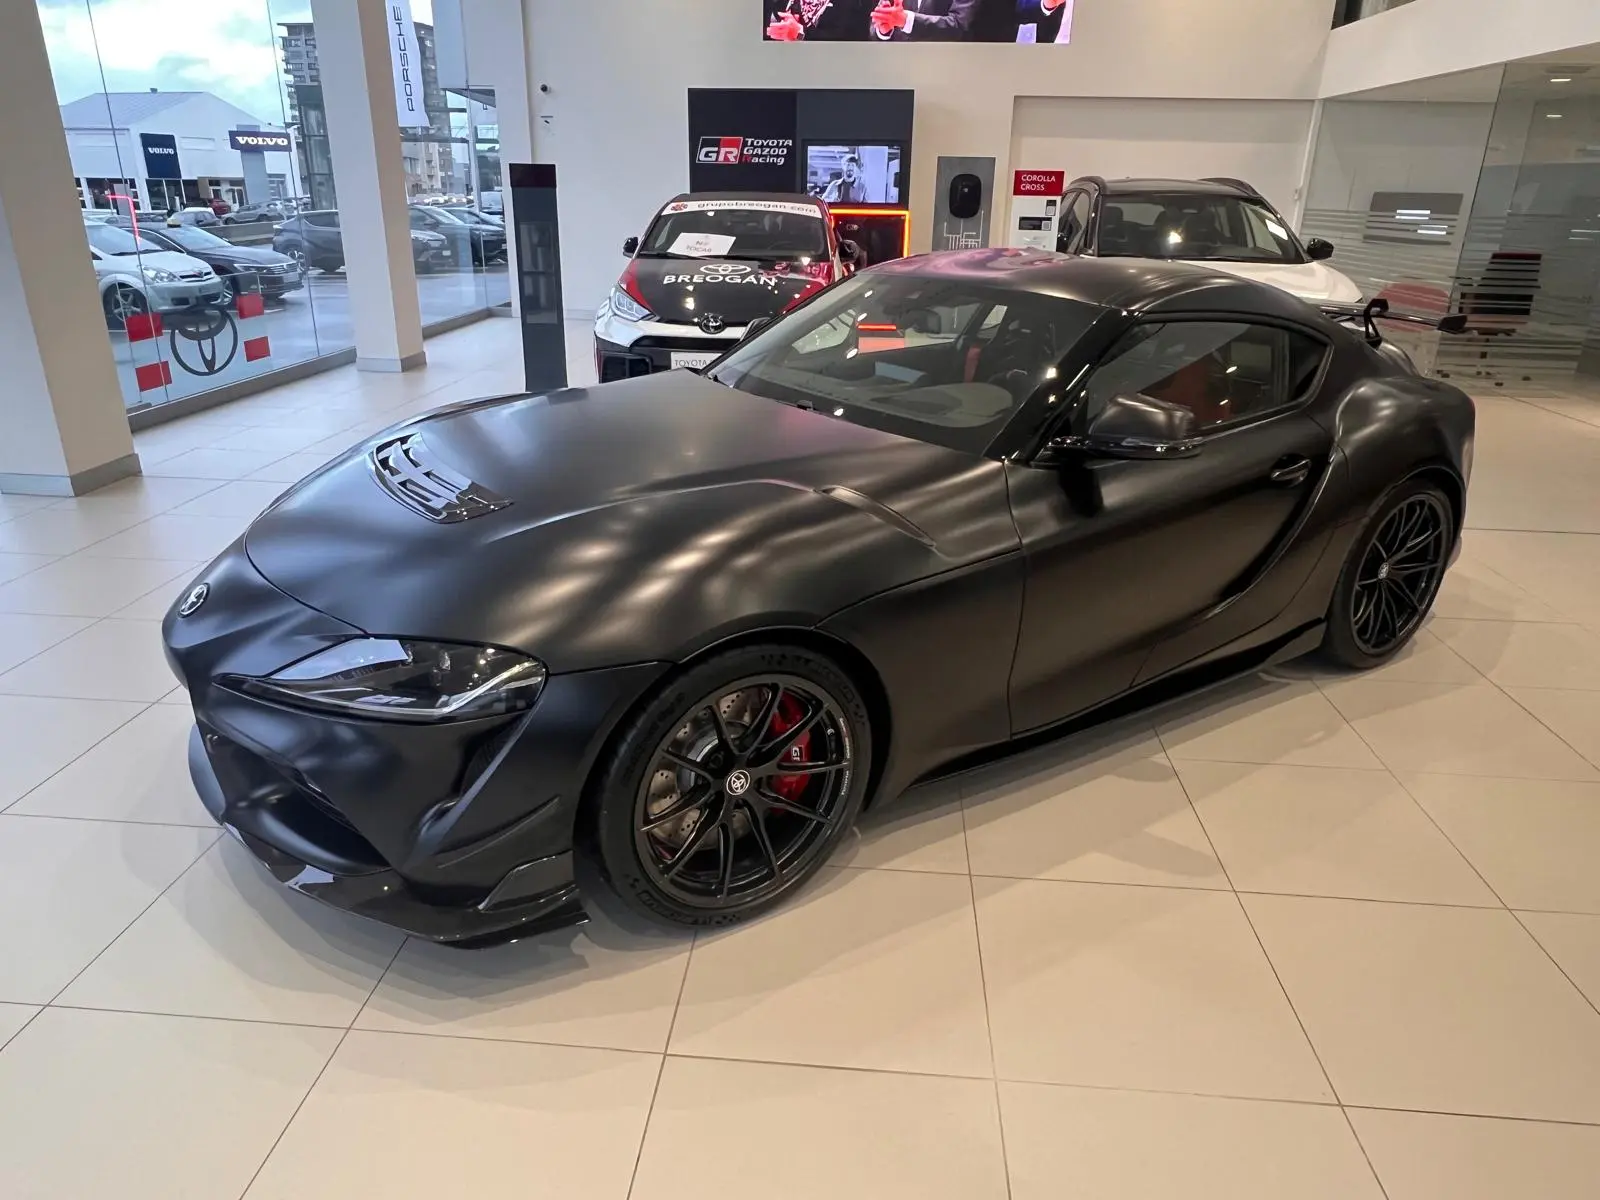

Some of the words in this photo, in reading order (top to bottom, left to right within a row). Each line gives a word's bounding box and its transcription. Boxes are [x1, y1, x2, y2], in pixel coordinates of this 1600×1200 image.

[393, 5, 415, 112] PORSCHE
[235, 136, 289, 146] VOLVO
[744, 138, 793, 146] TOYOTA
[148, 147, 175, 155] VOLVO
[699, 146, 739, 162] GR
[743, 146, 788, 155] GAZOO
[742, 155, 785, 166] Racing
[1021, 174, 1056, 182] COROLLA
[1020, 183, 1045, 191] CROSS
[674, 359, 708, 367] TOYOTA
